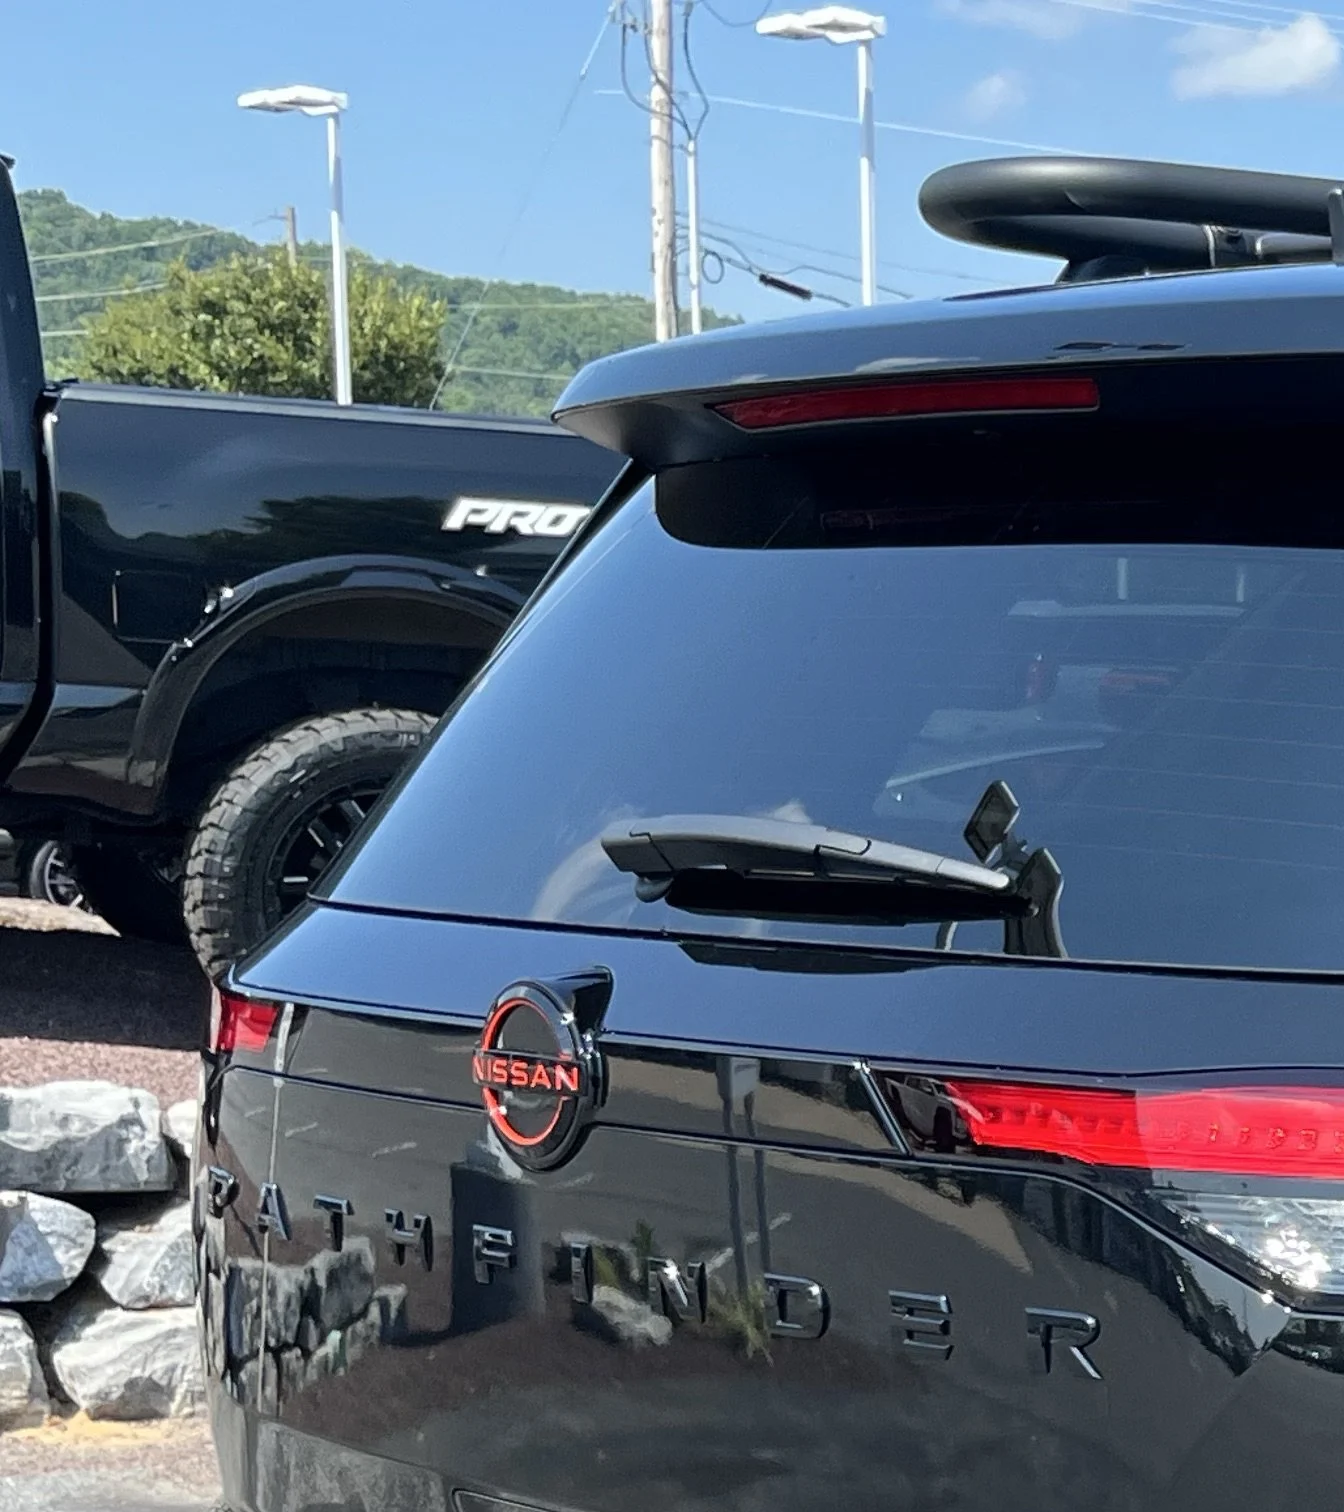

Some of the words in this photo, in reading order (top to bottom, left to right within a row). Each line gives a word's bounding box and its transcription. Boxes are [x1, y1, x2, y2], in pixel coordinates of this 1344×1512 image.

[440, 496, 591, 537] PRO
[472, 1055, 580, 1092] NISSAN
[206, 1164, 1104, 1381] PATHFINDER
